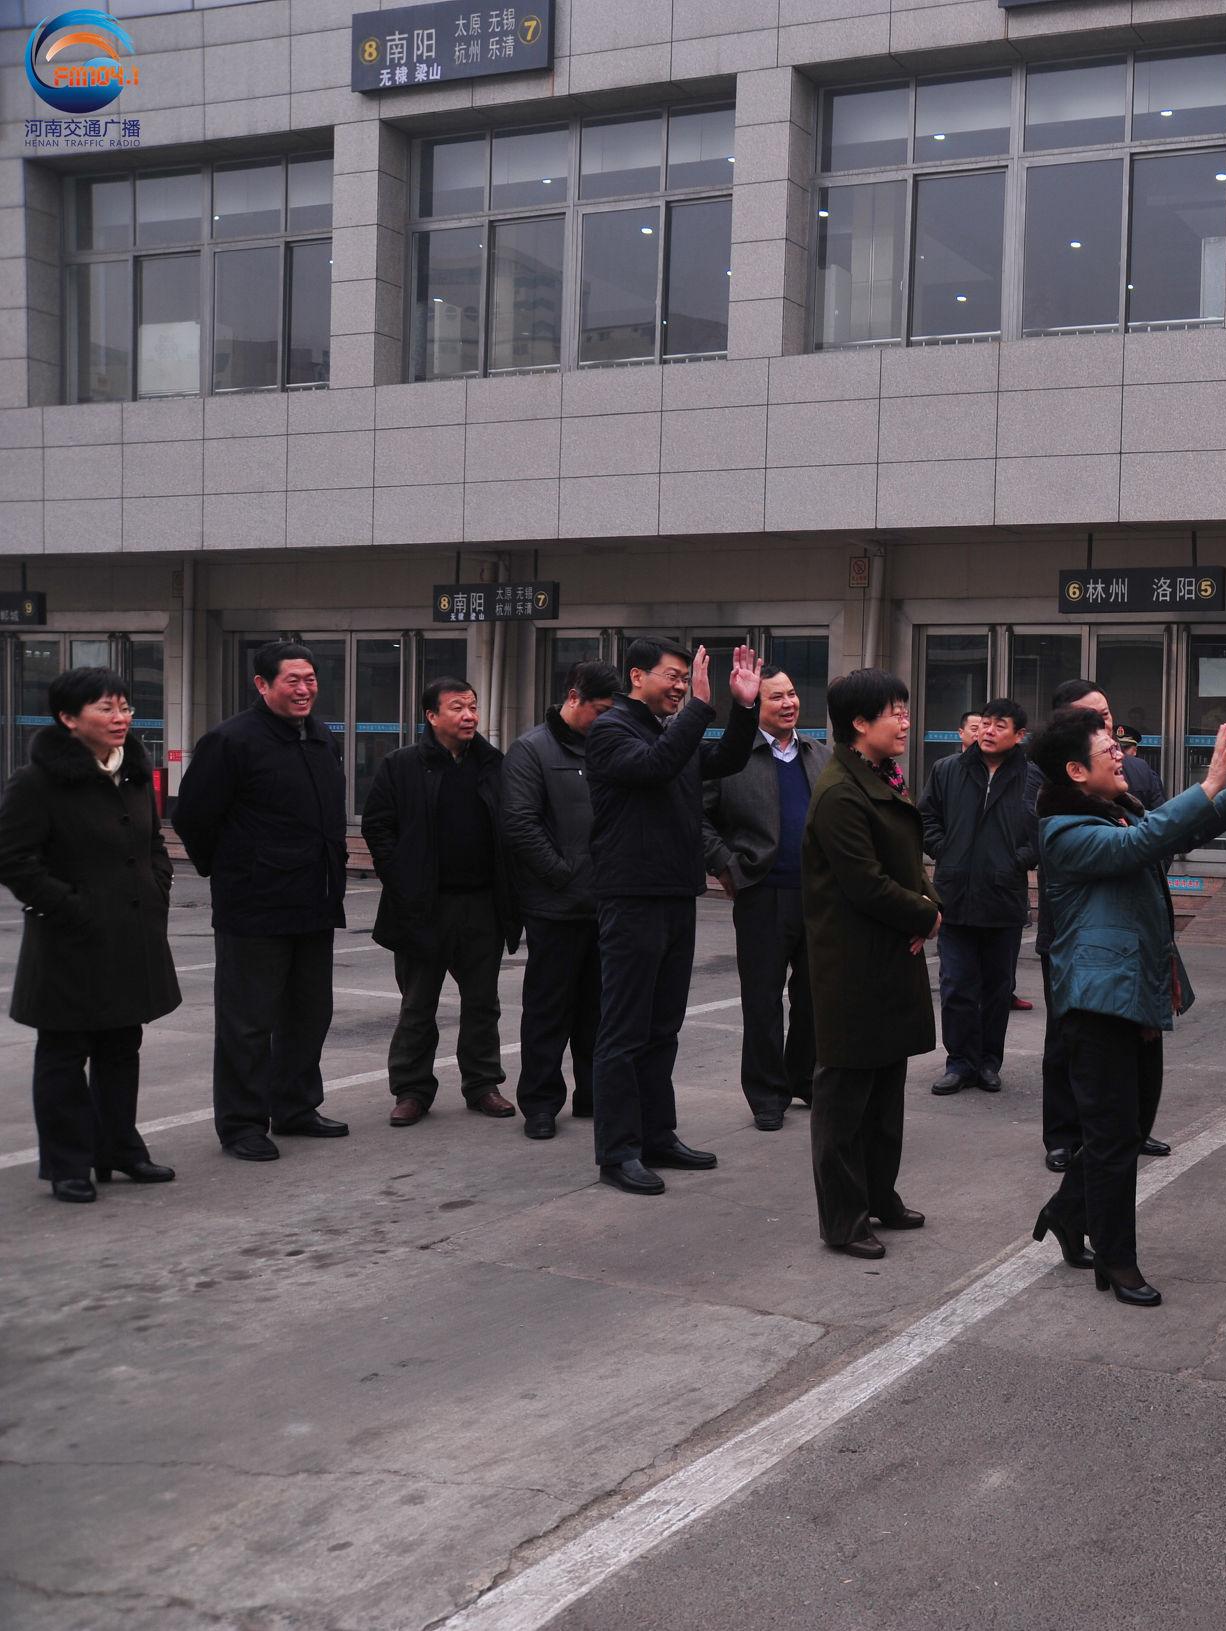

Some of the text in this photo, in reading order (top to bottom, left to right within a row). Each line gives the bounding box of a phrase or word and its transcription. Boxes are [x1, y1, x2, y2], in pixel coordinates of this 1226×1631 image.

[455, 8, 516, 37] 太原 无锡
[386, 29, 436, 66] 南阳
[454, 35, 515, 65] 杭州 乐清
[379, 63, 441, 87] 无棣 梁山
[453, 592, 485, 613] 南阳
[1086, 577, 1196, 603] 林州 洛阳
